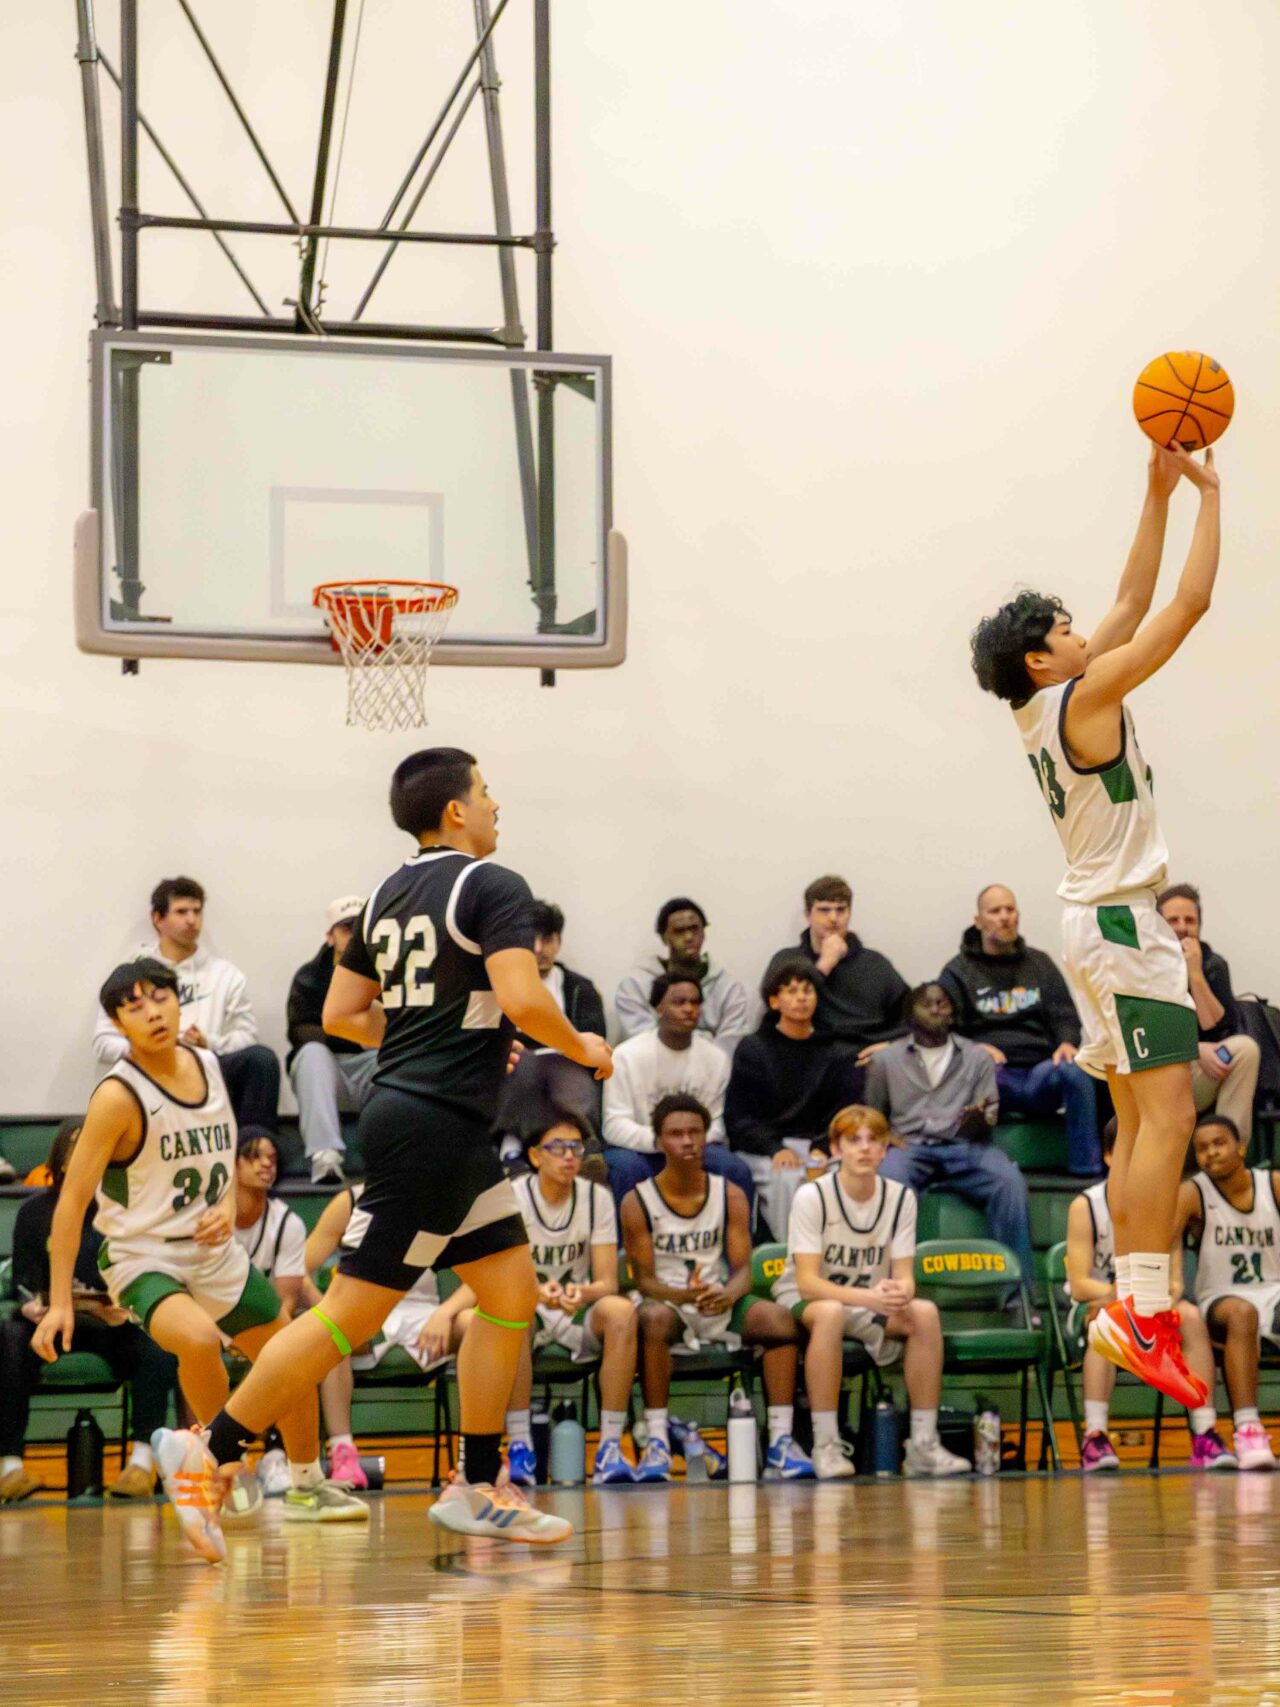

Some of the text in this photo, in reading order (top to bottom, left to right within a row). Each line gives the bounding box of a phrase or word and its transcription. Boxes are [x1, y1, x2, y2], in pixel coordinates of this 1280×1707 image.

[371, 914, 438, 1009] 22
[1132, 1027, 1149, 1059] C
[160, 1122, 232, 1162] CANYON
[655, 1228, 721, 1252] CANYON
[1214, 1225, 1276, 1247] CANYON
[531, 1239, 587, 1266] ANYON
[922, 1252, 1007, 1275] COWBOYS
[1230, 1252, 1265, 1285] 21
